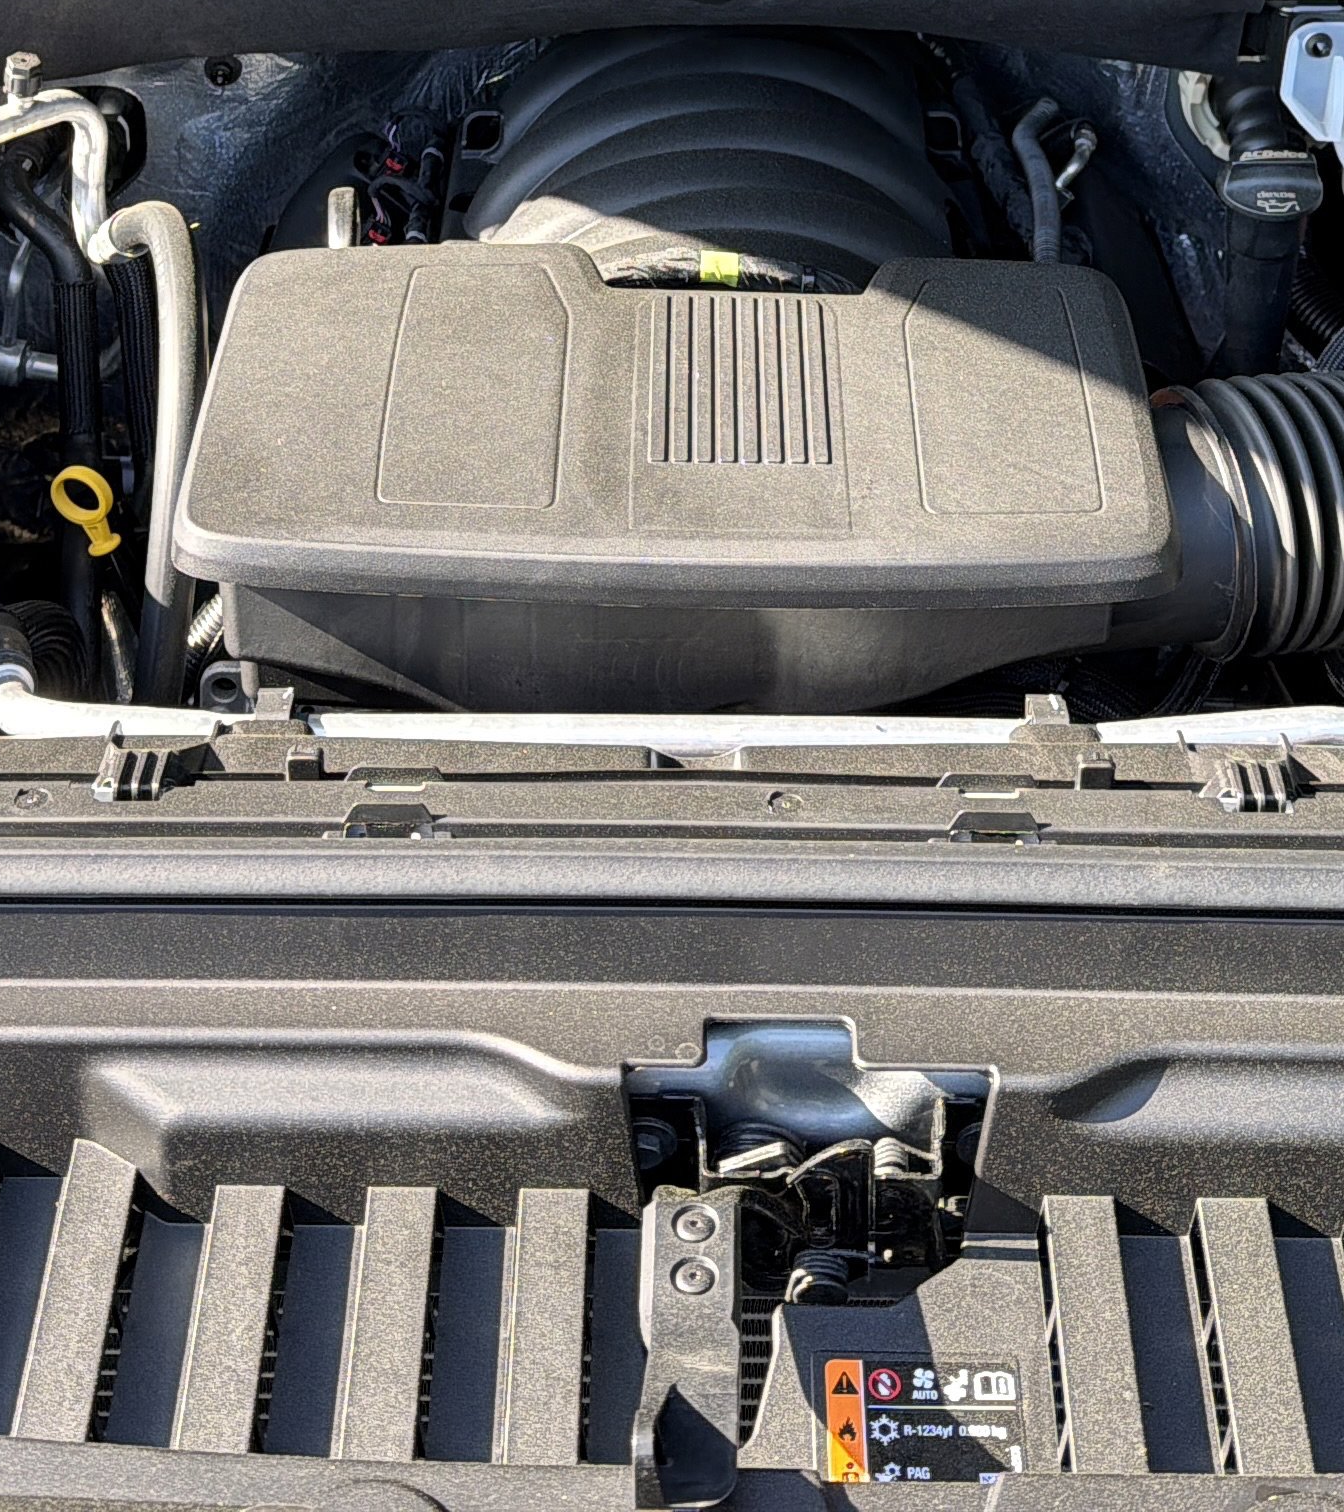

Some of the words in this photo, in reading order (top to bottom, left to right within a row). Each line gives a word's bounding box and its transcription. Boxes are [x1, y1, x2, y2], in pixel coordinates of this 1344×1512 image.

[1239, 150, 1308, 161] ACDelco
[1257, 190, 1296, 198] dexos
[912, 1390, 938, 1400] AUTO
[903, 1425, 953, 1439] R-1234yf
[907, 1467, 931, 1479] PAG
